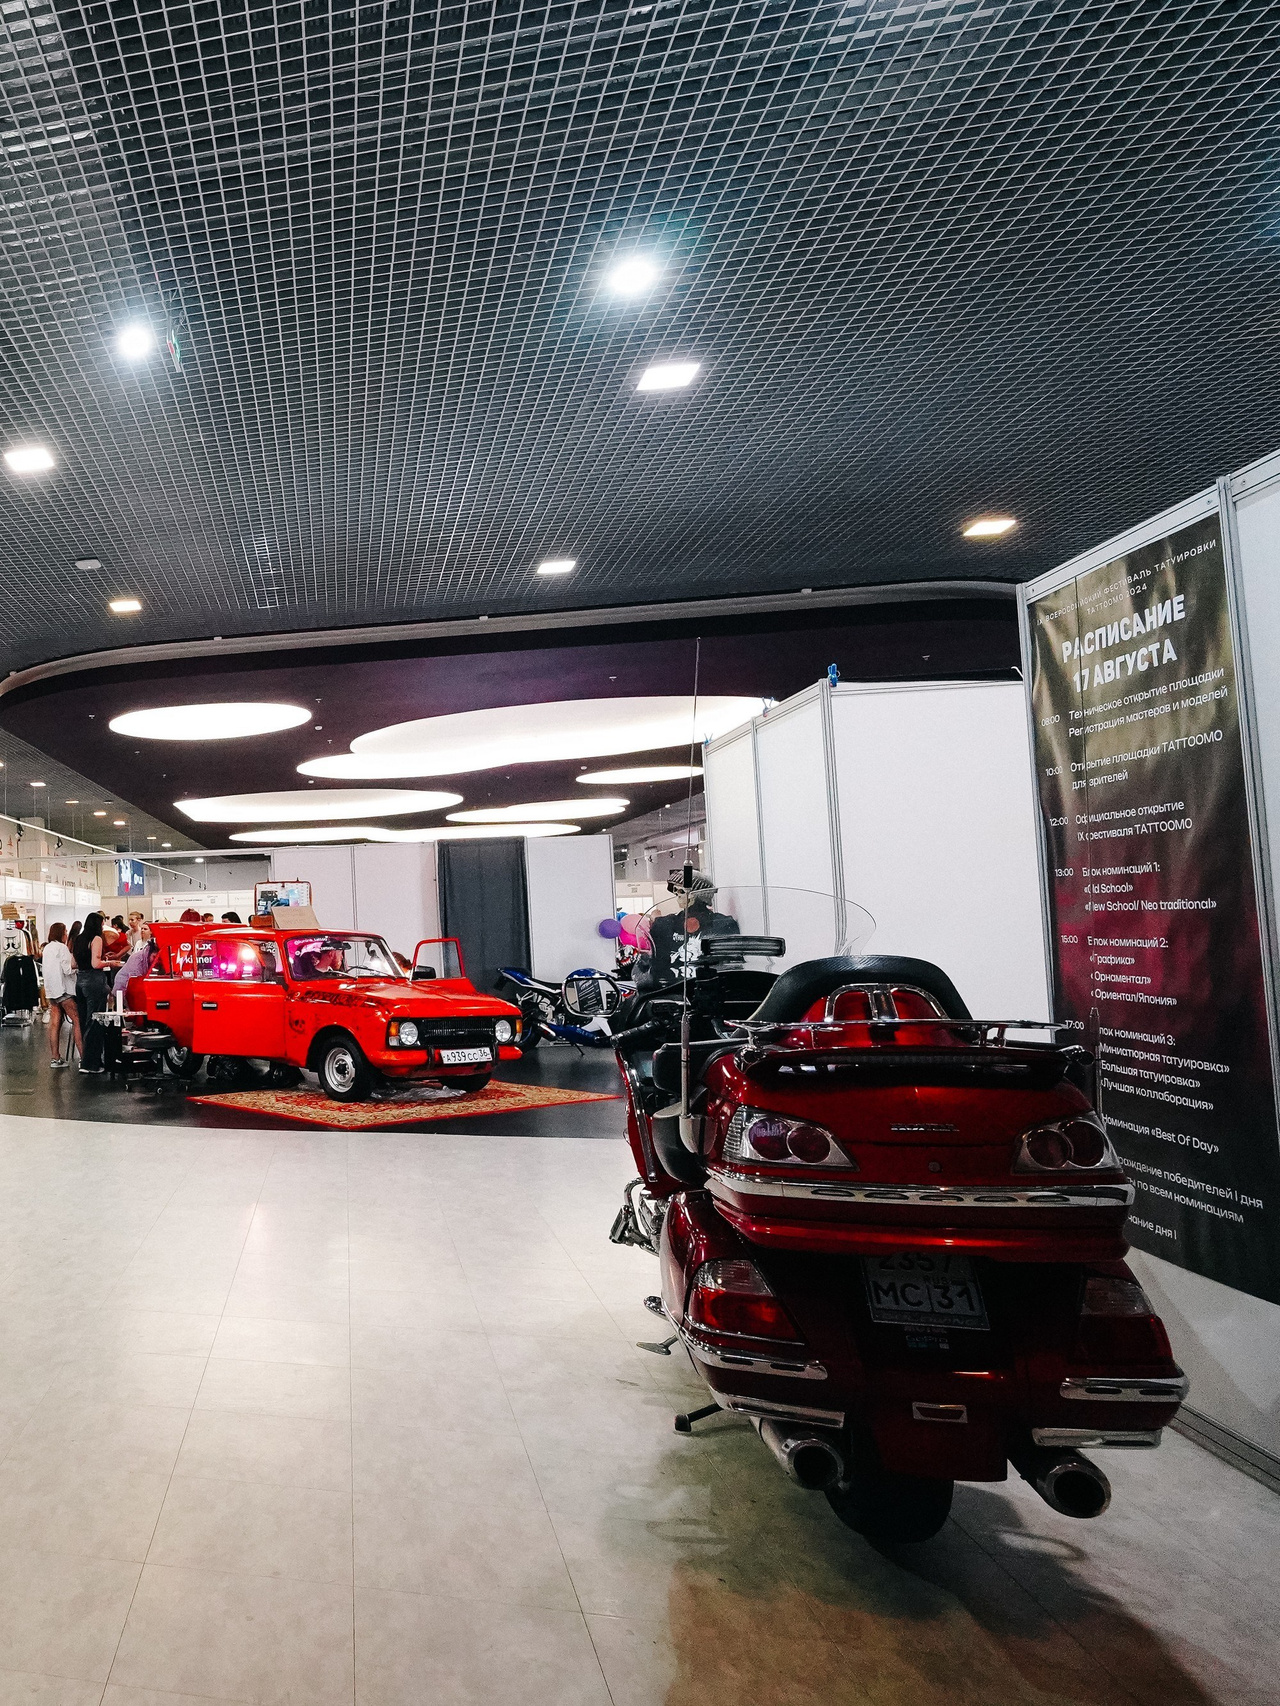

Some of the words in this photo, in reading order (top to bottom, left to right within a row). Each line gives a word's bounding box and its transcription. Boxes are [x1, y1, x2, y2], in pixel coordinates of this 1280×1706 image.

[1103, 568, 1152, 594] ФЕСТИВАЛЬ
[1153, 538, 1217, 572] ТАТУИРОВКИ
[1126, 583, 1148, 598] 2024
[1061, 593, 1186, 664] РАСПИСАНИЕ
[1072, 667, 1090, 694] 17
[1093, 638, 1178, 688] АВГУСТА
[1068, 699, 1122, 721] Техническое
[1123, 684, 1168, 706] открытие
[1168, 667, 1225, 693] площадки
[1068, 716, 1125, 738] Регистрация
[1125, 704, 1171, 725] мастеров
[1180, 686, 1228, 708] моделей
[1045, 767, 1063, 777] 10:00
[1070, 753, 1111, 773] Открытие
[1112, 744, 1160, 764] площадки
[1072, 779, 1087, 790] для
[1089, 769, 1129, 788] зрителей
[1049, 816, 1069, 827] 12:00
[1075, 807, 1136, 825] Официальное
[1138, 801, 1185, 816] открытие
[1054, 867, 1074, 877] 13:00
[1102, 863, 1153, 876] номинаций
[1101, 881, 1134, 894] School»
[1107, 900, 1139, 911] School/
[1141, 900, 1158, 911] Neo
[1159, 897, 1217, 911] traditional»
[1109, 936, 1159, 948] номинаций
[1160, 937, 1169, 948] 2:
[1065, 1020, 1085, 1030] 17:00
[1099, 1026, 1114, 1036] лок
[1114, 1030, 1166, 1045] номинаций
[1167, 1034, 1176, 1046] 3:
[1101, 1060, 1138, 1076] Большая
[1139, 1069, 1201, 1088] татуировка»
[1161, 1054, 1230, 1073] татуировка»
[1135, 1086, 1214, 1111] коллаборация»
[1101, 1113, 1150, 1136] Номинация
[1151, 1128, 1176, 1143] «Best
[1177, 1134, 1191, 1146] Of
[1192, 1138, 1219, 1154] Day»
[1137, 1181, 1149, 1192] по
[1150, 1185, 1173, 1201] всем
[1173, 1191, 1245, 1224] номинациям
[1163, 1171, 1233, 1202] победителей
[1240, 1194, 1264, 1210] дня
[1155, 1224, 1173, 1238] дня
[933, 1283, 976, 1312] 31
